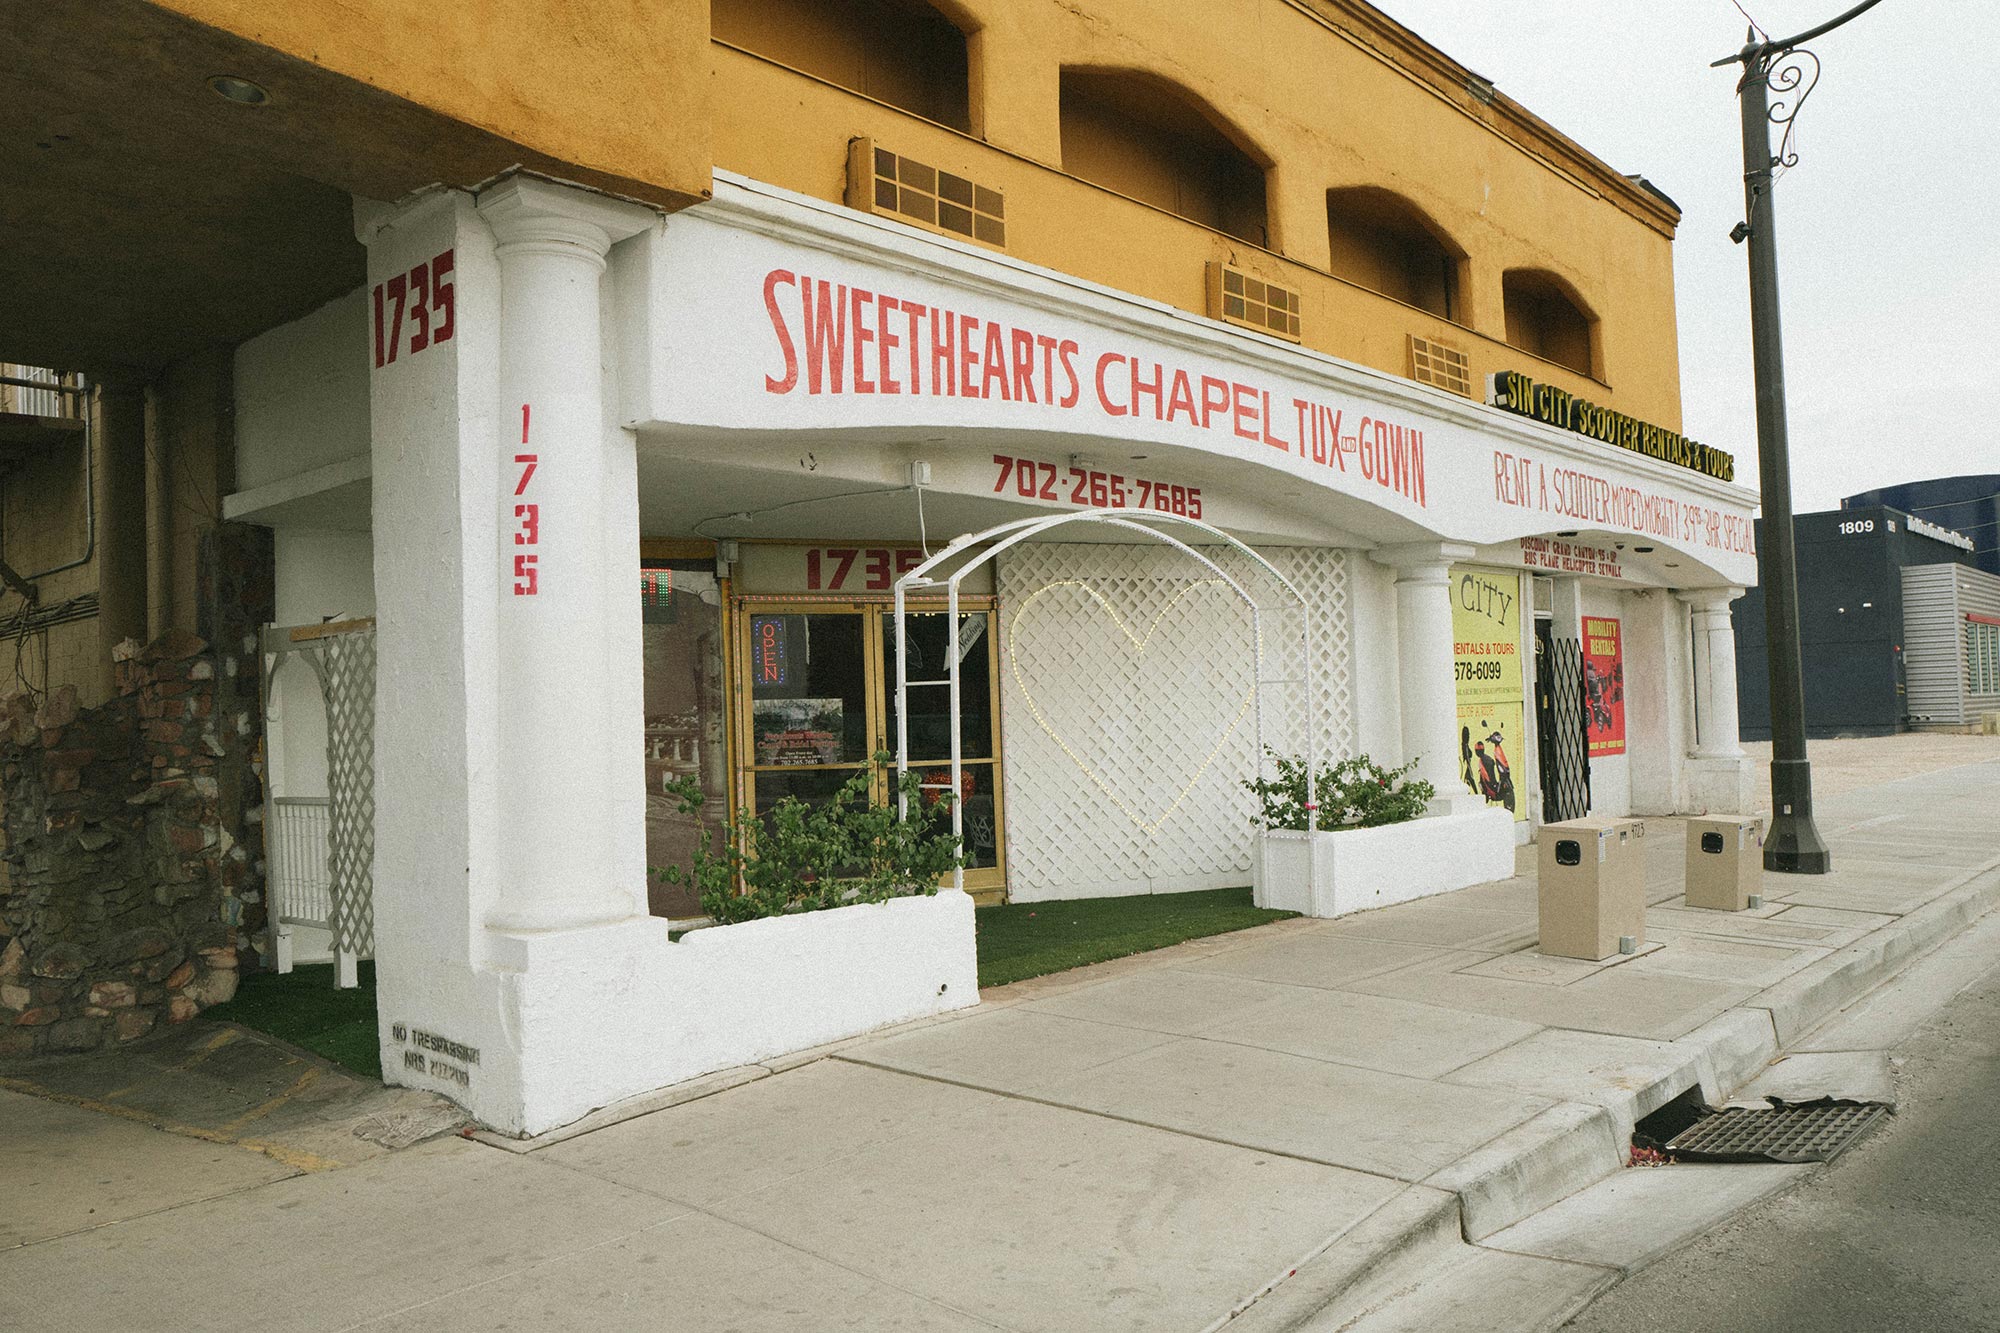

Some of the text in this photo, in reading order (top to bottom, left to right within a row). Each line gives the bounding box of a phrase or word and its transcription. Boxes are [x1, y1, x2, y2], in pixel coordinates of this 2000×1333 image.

[372, 248, 455, 369] 1735
[763, 268, 1080, 409] SWEETHEARTS
[1096, 352, 1290, 453] CHAPEL
[1293, 398, 1346, 473] TUX
[1359, 416, 1427, 509] GOWN
[1506, 372, 1734, 482] SIN CITY SCOOTER RENTALS & TOURS
[513, 403, 539, 596] 1735
[1493, 450, 1532, 509] RENT
[1539, 463, 1549, 513] A
[1553, 467, 1611, 525] SCOOTER
[1611, 483, 1645, 532] MOPED
[1723, 513, 1757, 556] SPECIAL
[1838, 519, 1875, 535] 1809
[1520, 536, 1550, 553] DISCOUNT
[1552, 541, 1572, 557] GRAND
[1523, 551, 1537, 566] BUS
[1540, 553, 1560, 570] PLANE
[1562, 556, 1596, 574] HELICOPTER
[1587, 619, 1617, 638] MOBILITY
[761, 623, 778, 682] OPEN
[1485, 642, 1492, 655] &
[1492, 642, 1515, 655] TOURS
[1590, 638, 1616, 657] RENTALS
[1454, 661, 1502, 681] 678-6099
[392, 1024, 408, 1042] NO
[404, 1049, 427, 1073] NRS
